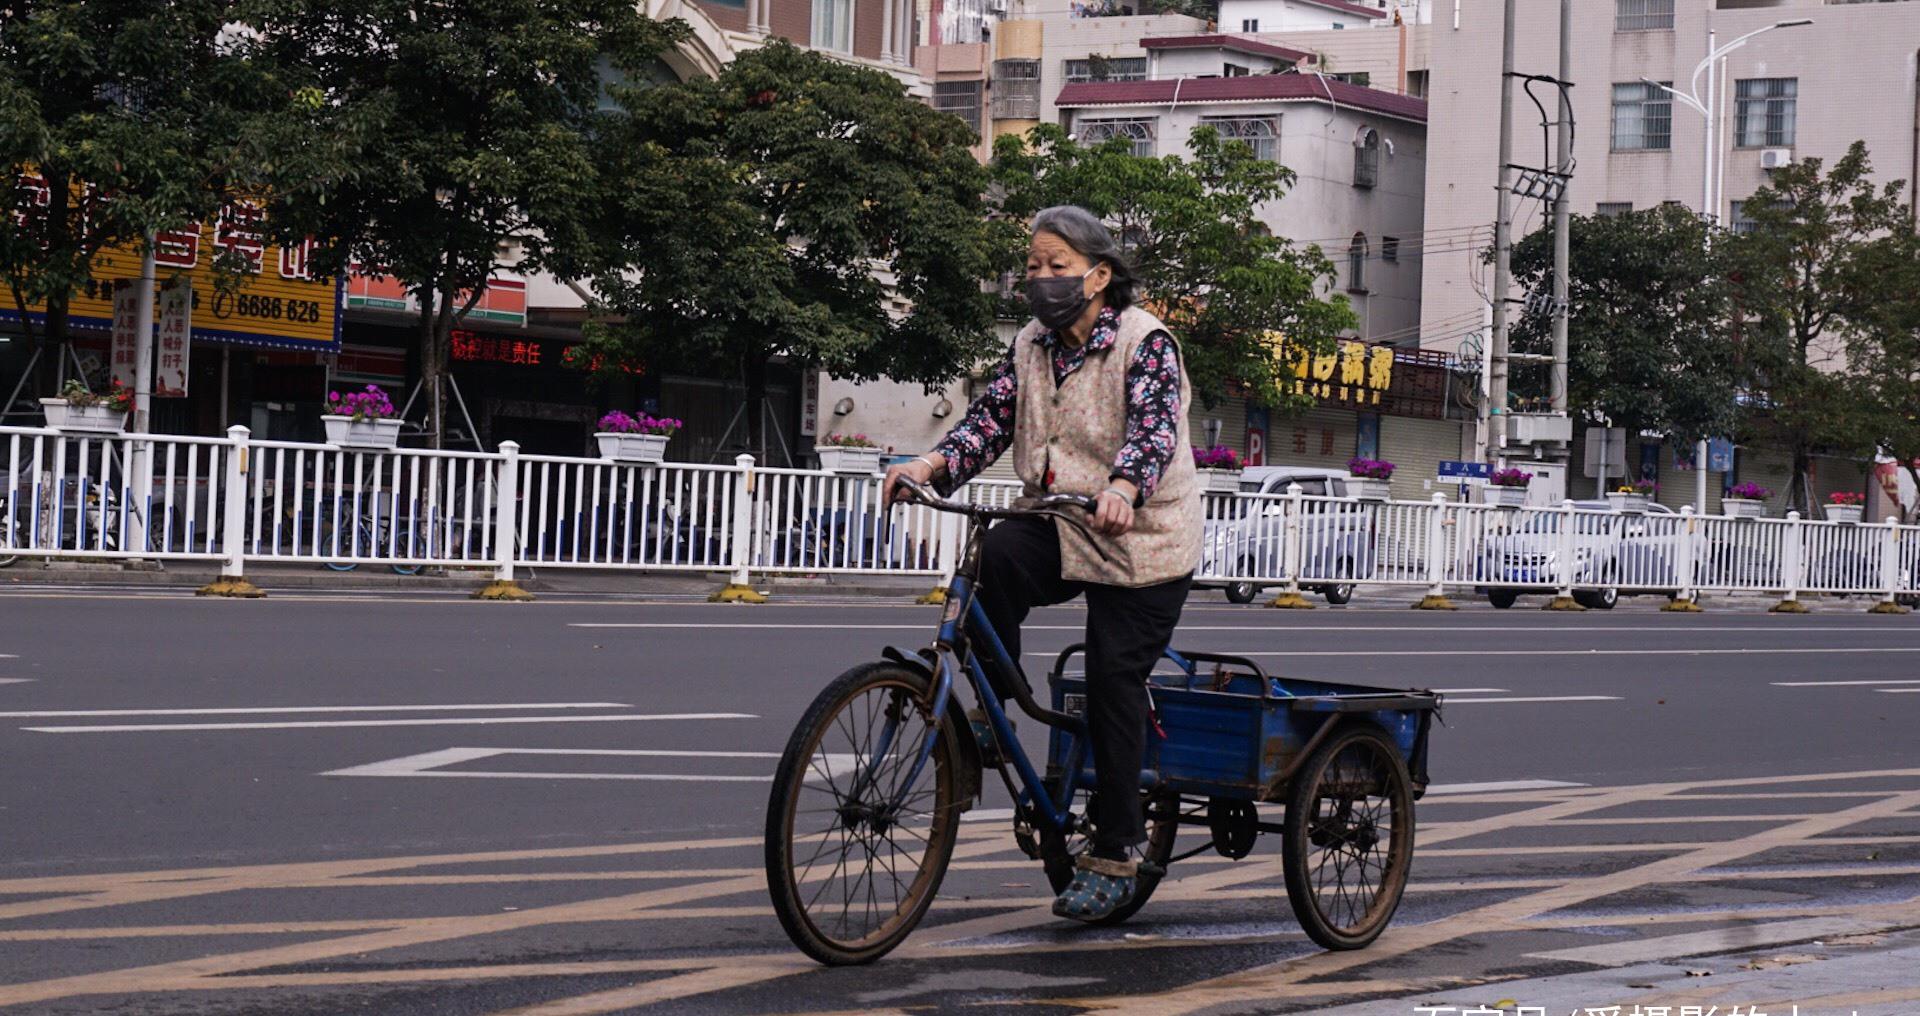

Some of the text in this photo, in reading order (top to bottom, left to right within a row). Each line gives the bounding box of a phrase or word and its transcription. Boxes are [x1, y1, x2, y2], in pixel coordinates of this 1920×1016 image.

[238, 294, 319, 323] 6686 626
[1249, 432, 1262, 466] P
